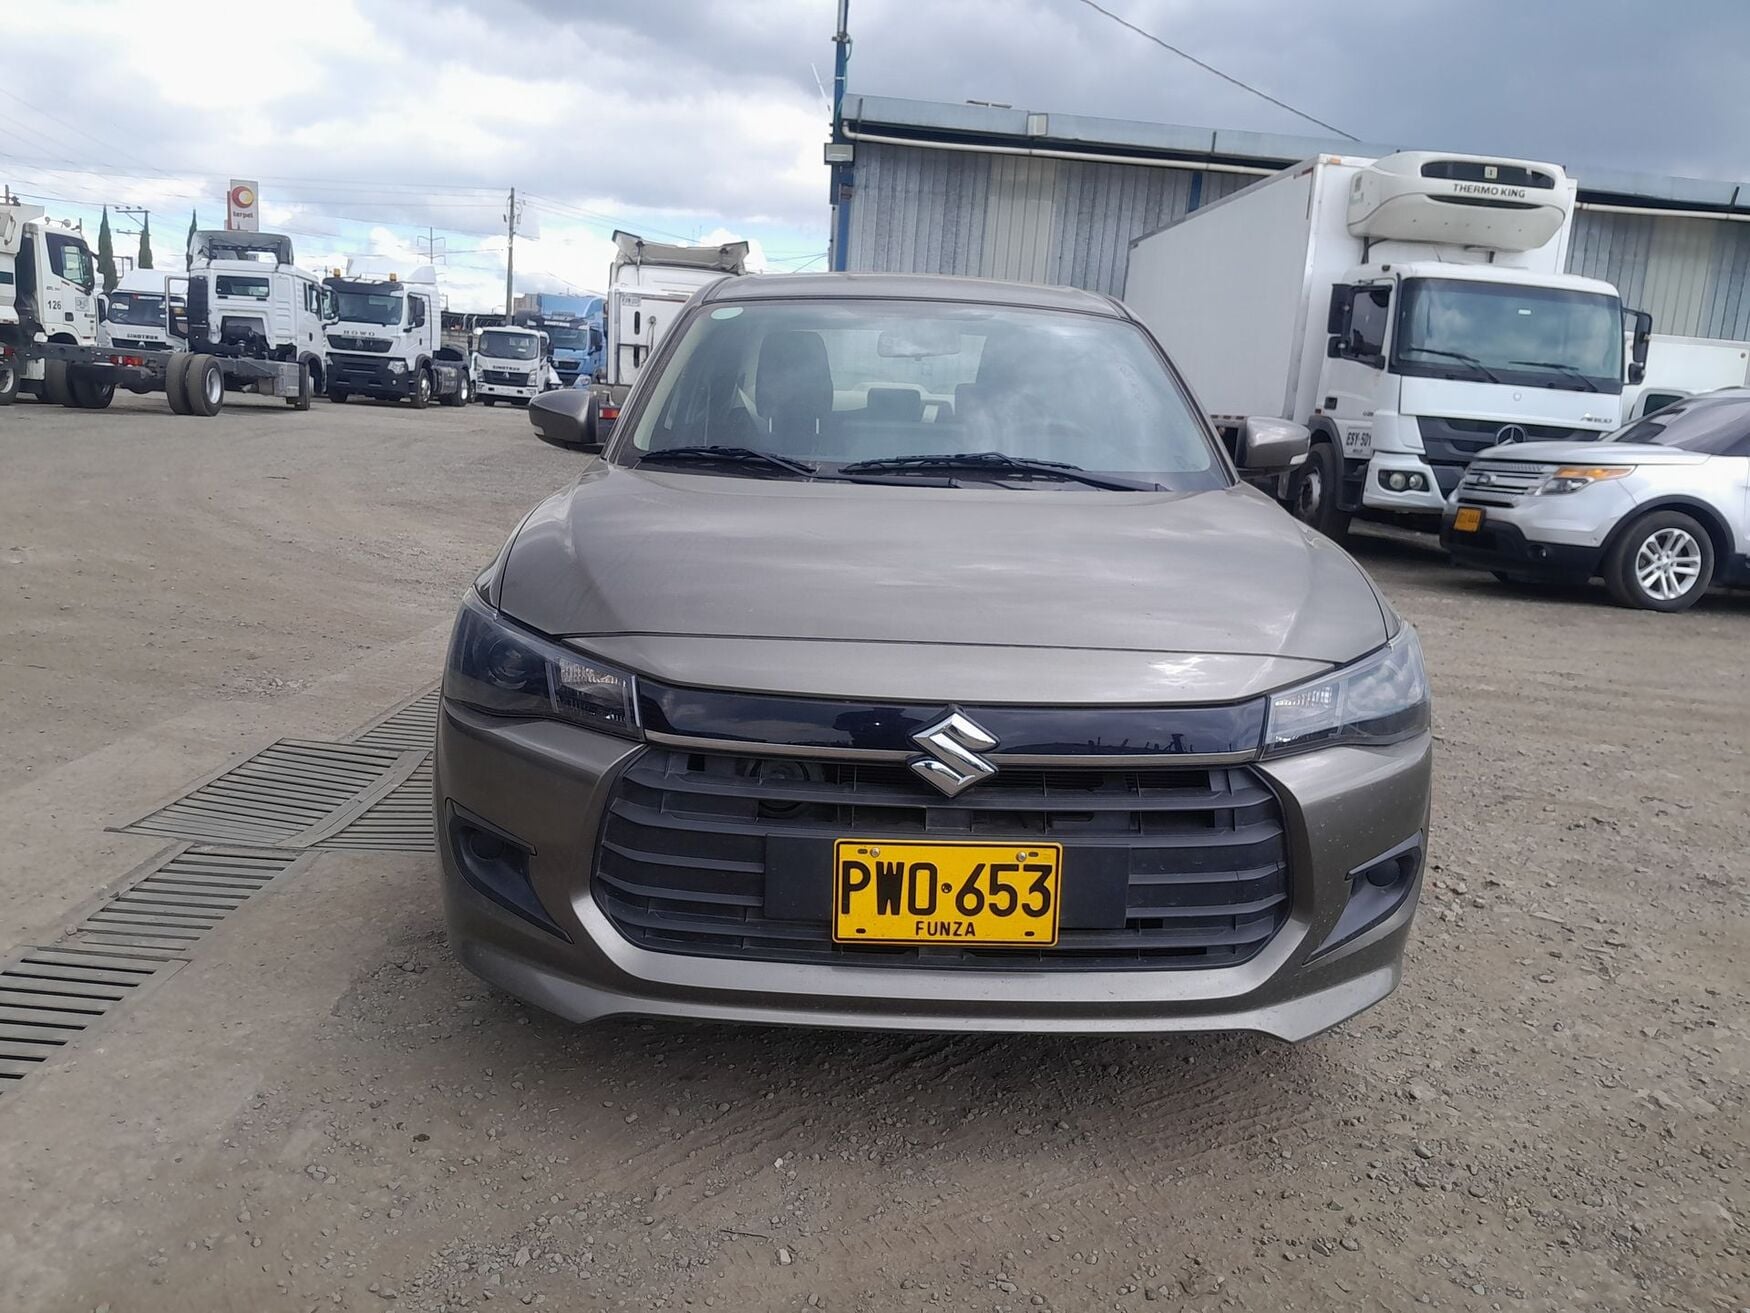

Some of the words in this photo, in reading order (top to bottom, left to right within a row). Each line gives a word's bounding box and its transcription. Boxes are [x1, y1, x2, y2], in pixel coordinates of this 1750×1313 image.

[1453, 183, 1499, 196] THERMO
[1500, 187, 1526, 198] KING
[47, 300, 62, 310] 126
[915, 921, 976, 937] FUNZA
